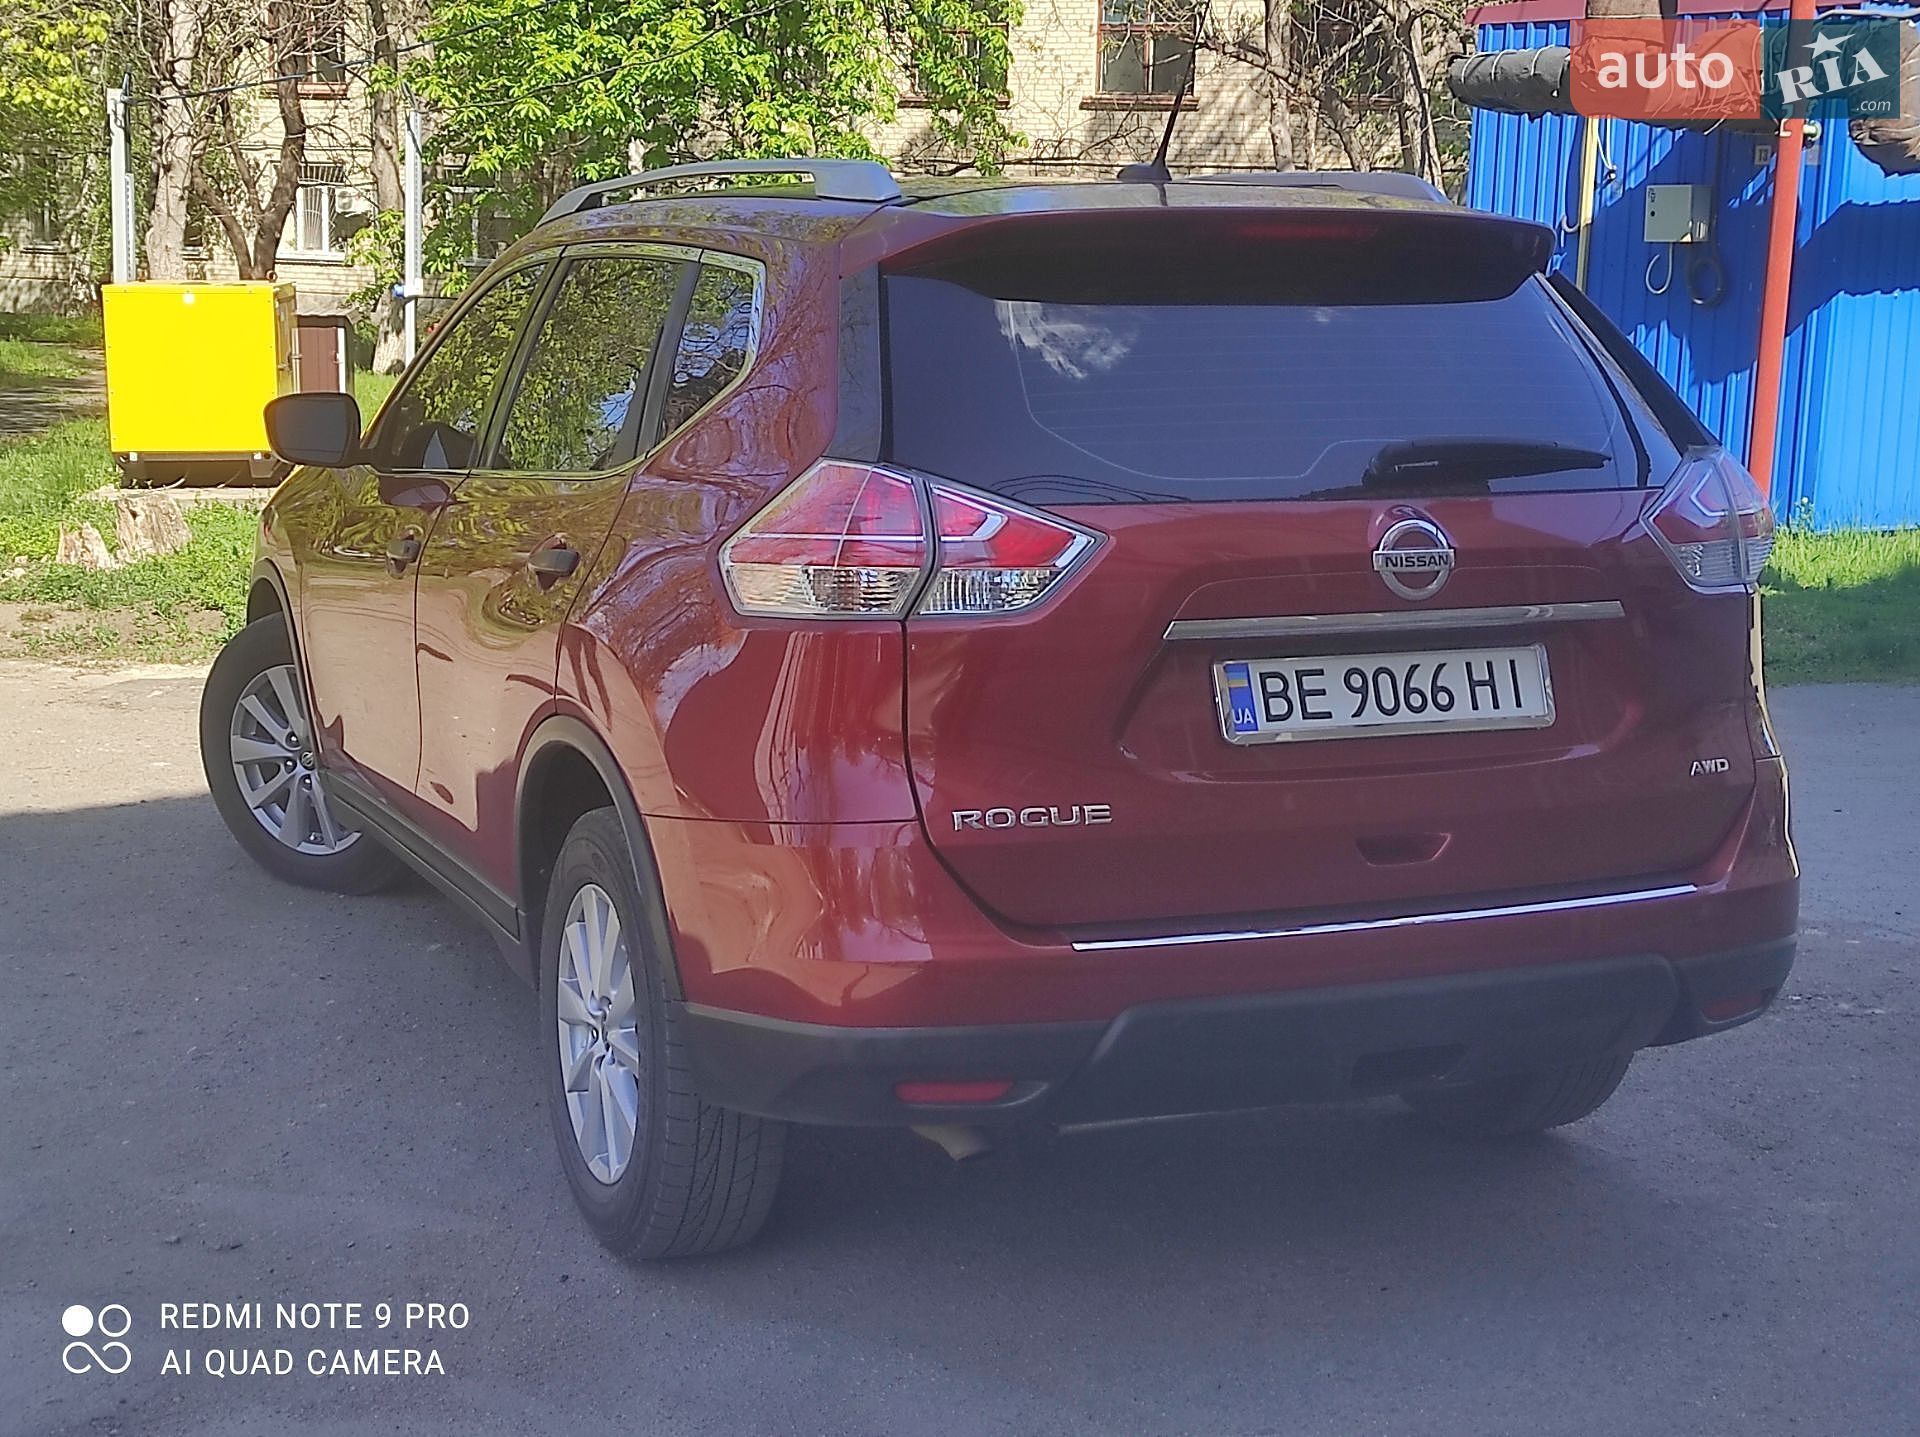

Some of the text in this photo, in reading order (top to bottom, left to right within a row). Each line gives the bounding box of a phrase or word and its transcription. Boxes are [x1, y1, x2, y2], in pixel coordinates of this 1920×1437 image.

[1385, 554, 1449, 568] NISSAN
[1258, 659, 1523, 723] BE 9066 HI
[1232, 710, 1255, 727] UA
[1690, 758, 1730, 777] AWD
[951, 803, 1113, 831] ROGUE
